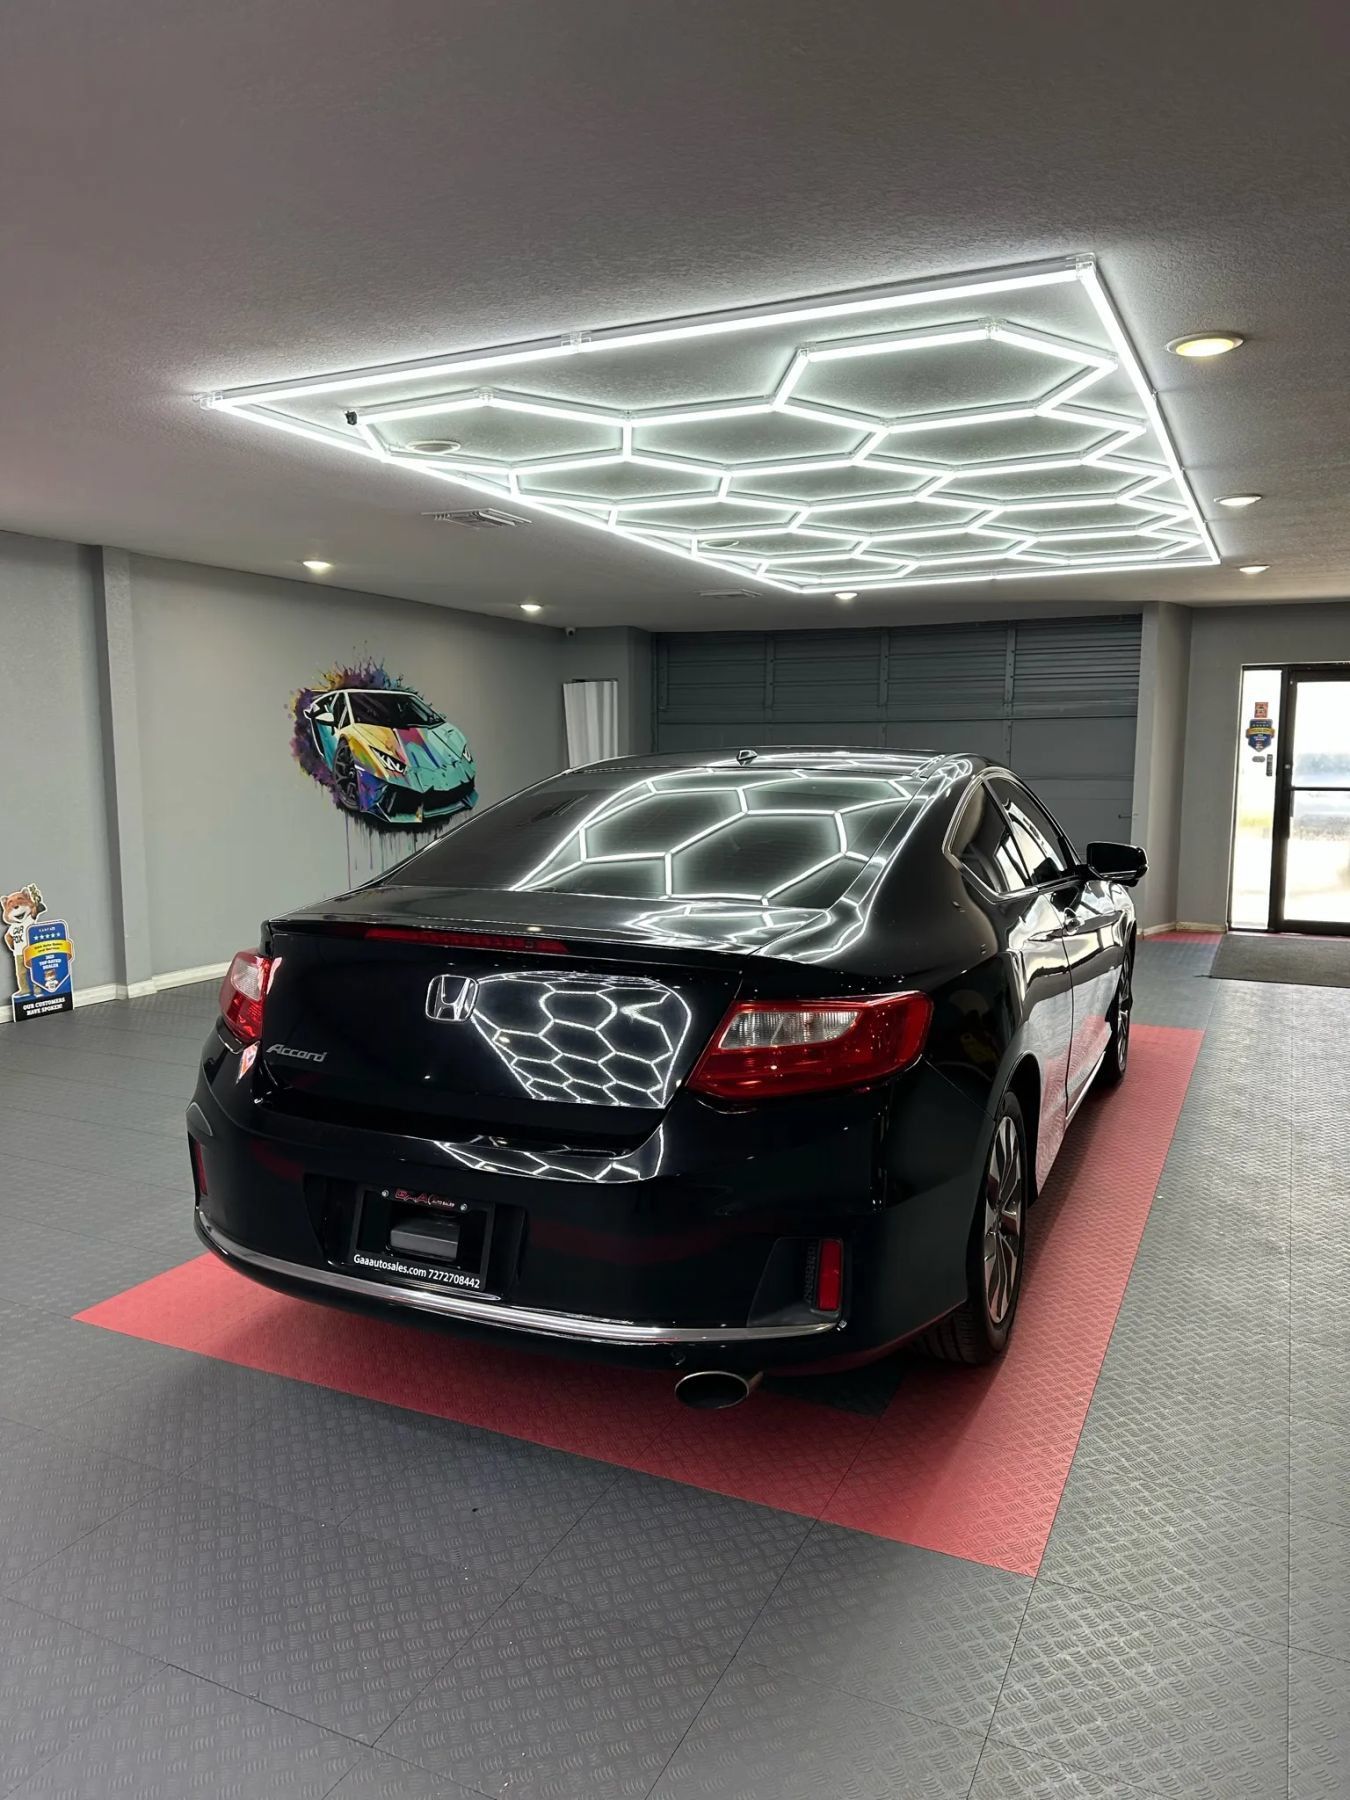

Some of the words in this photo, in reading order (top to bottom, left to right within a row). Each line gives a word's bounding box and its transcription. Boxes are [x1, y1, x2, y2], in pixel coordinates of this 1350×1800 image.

[22, 1003, 35, 1011] OUR
[35, 997, 65, 1008] CUSTOMERS
[26, 1008, 41, 1016] HAVE
[265, 1043, 328, 1063] Accord
[353, 1254, 427, 1277] Gaaautosales.com
[428, 1269, 481, 1289] 7272708442
